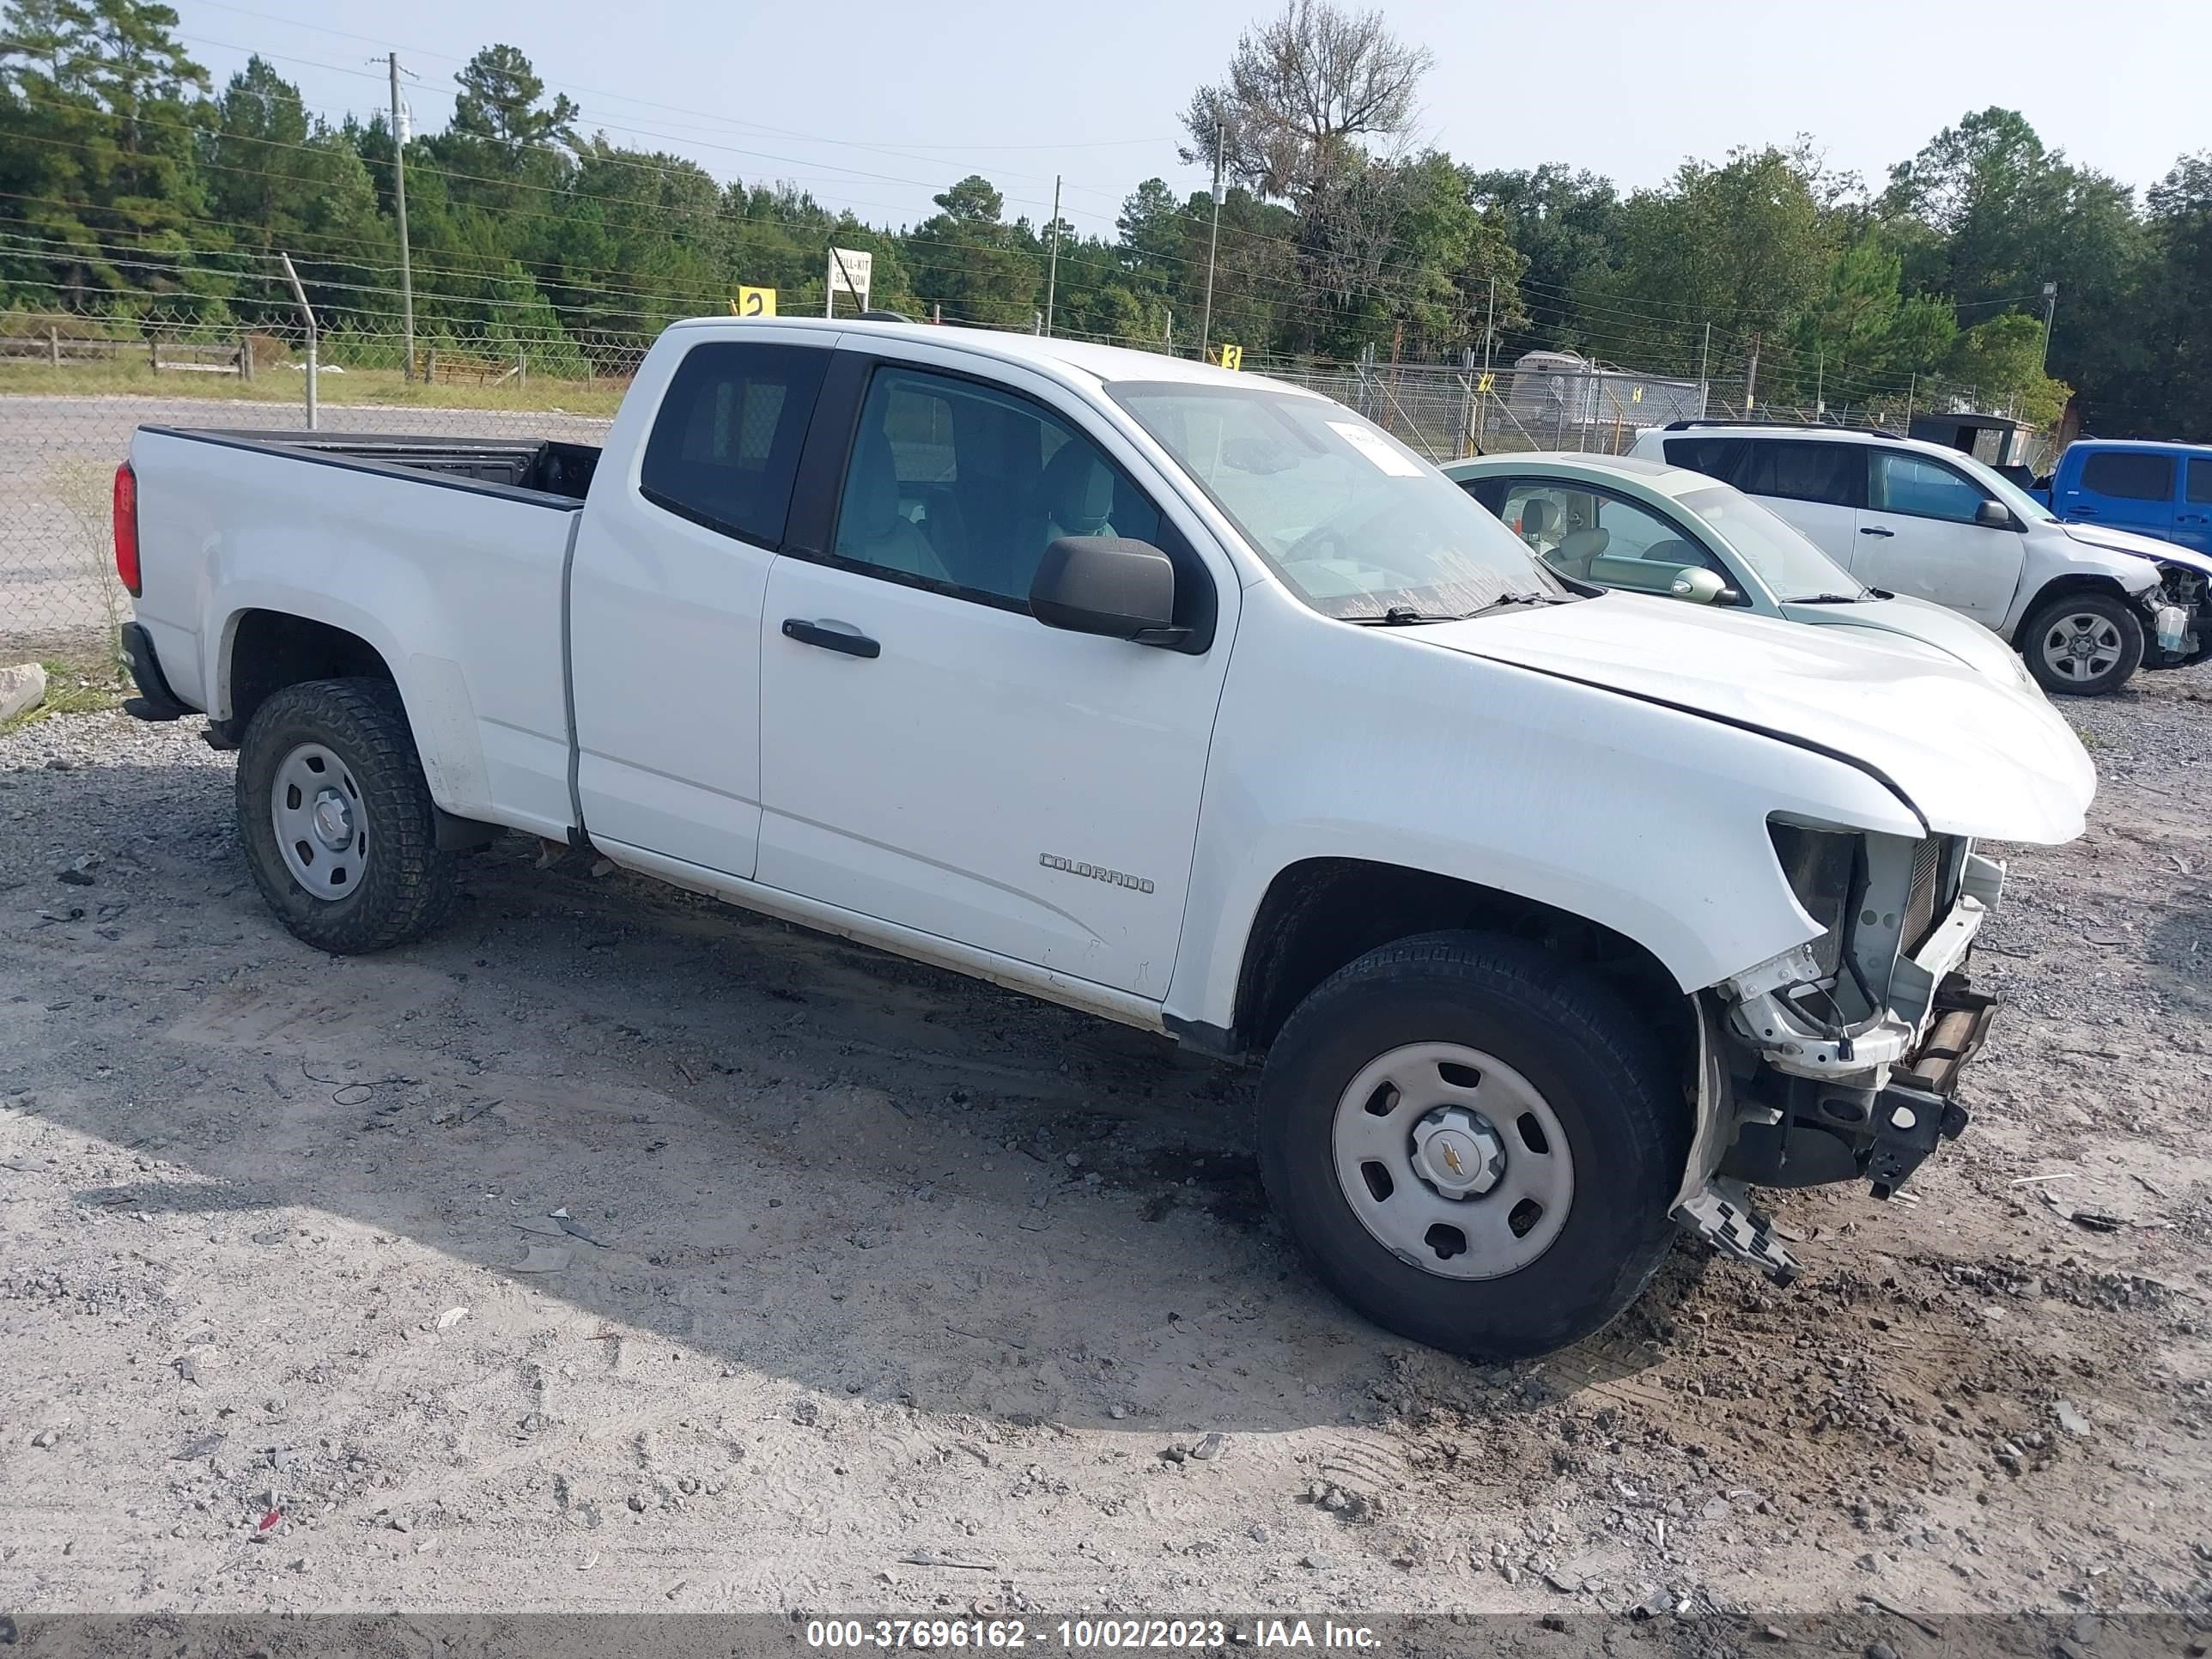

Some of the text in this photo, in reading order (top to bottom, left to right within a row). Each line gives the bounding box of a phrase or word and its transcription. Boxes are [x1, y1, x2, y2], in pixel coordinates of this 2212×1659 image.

[746, 292, 763, 316] 2
[1226, 347, 1237, 370] 3
[1039, 852, 1154, 894] COLORADO
